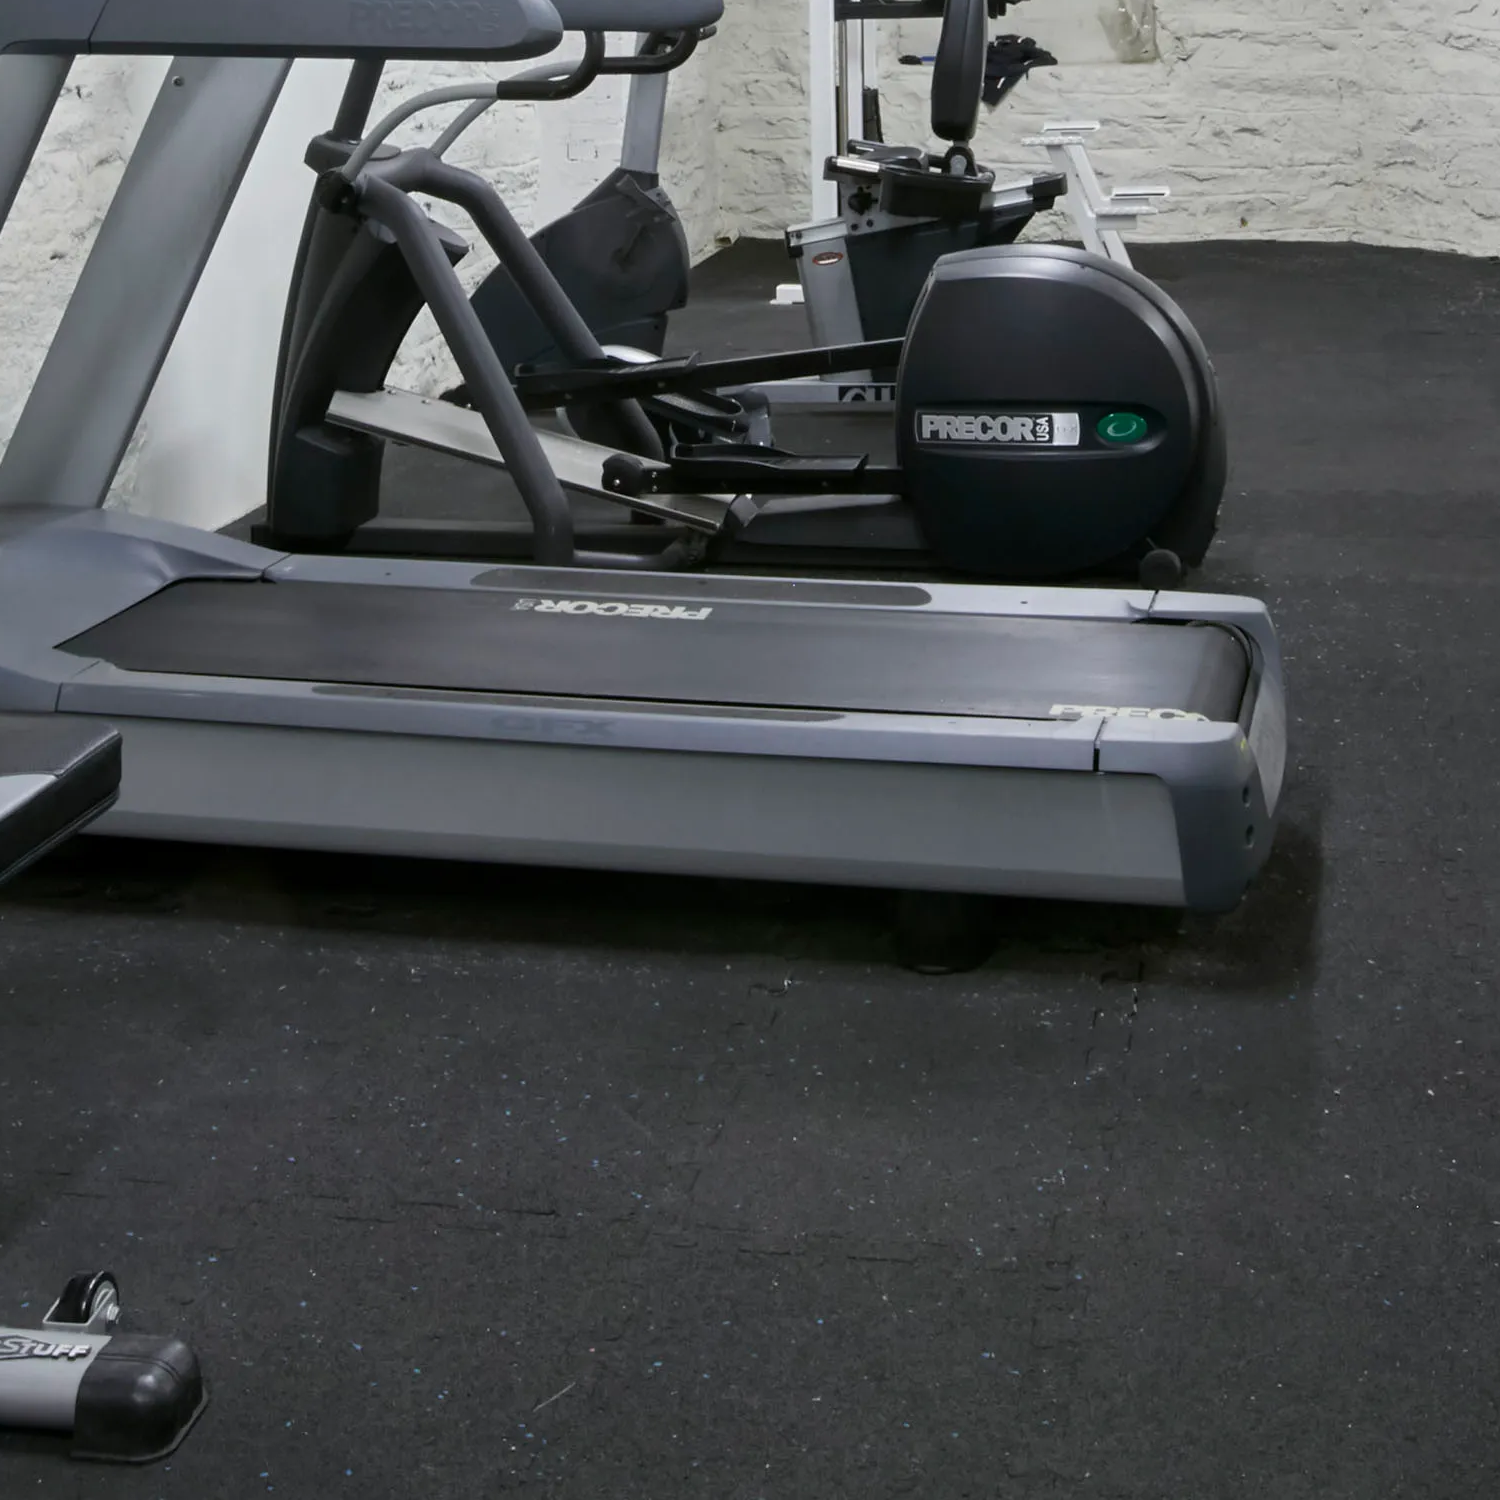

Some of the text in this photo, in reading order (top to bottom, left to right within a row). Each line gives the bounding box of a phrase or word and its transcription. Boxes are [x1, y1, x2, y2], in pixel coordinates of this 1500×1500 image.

[922, 414, 1050, 442] PRECOR USA
[533, 598, 714, 621] PRECOR
